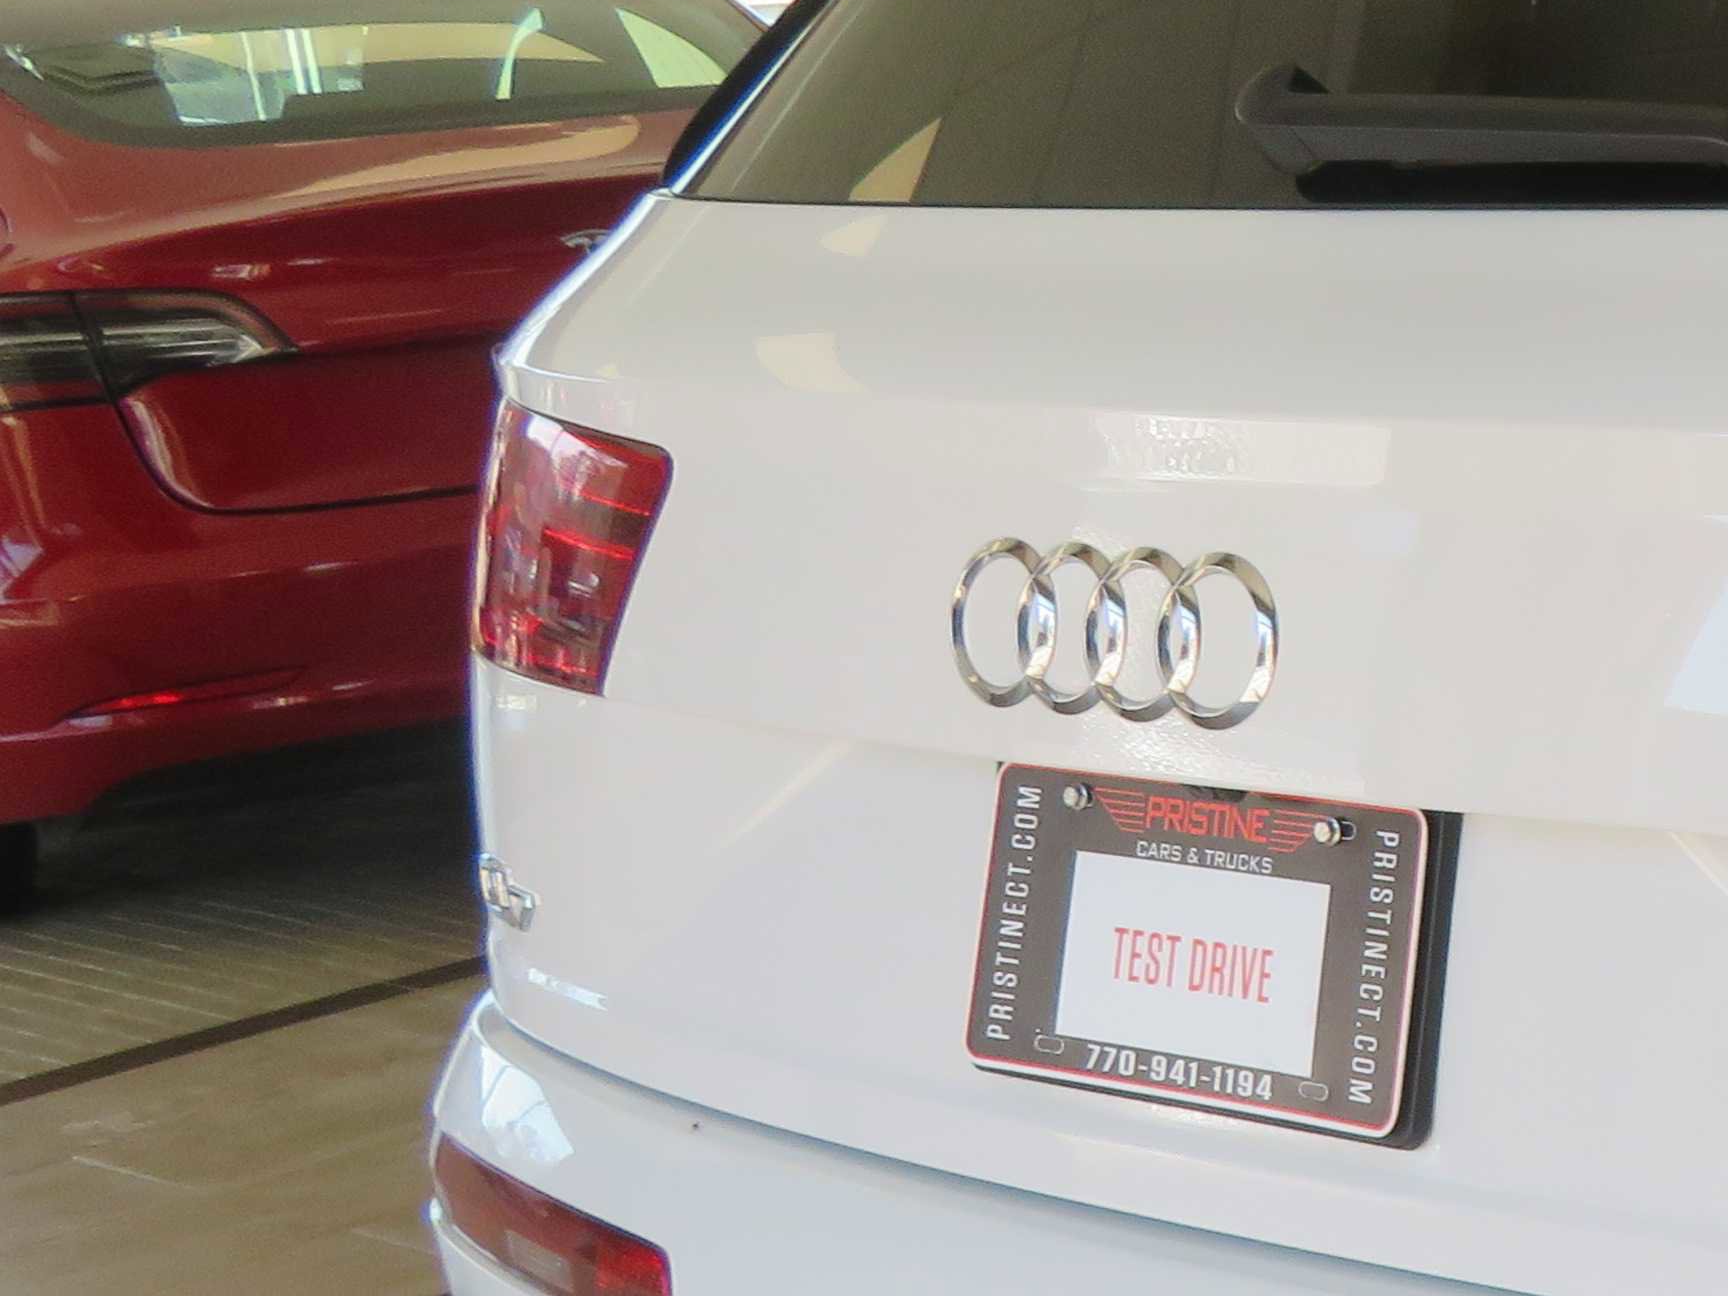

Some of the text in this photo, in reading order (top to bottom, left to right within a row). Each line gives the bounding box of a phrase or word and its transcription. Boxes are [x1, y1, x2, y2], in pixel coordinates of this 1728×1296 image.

[1143, 795, 1269, 844] PRISTINE
[1136, 840, 1273, 874] CARS & TRUCKS
[986, 785, 1042, 1040] PRISTINECT.COM
[1113, 927, 1275, 1003] TEST DRIVE
[1348, 829, 1399, 1104] PRISTINECT.COM
[1084, 1044, 1273, 1101] 770-941-1194
